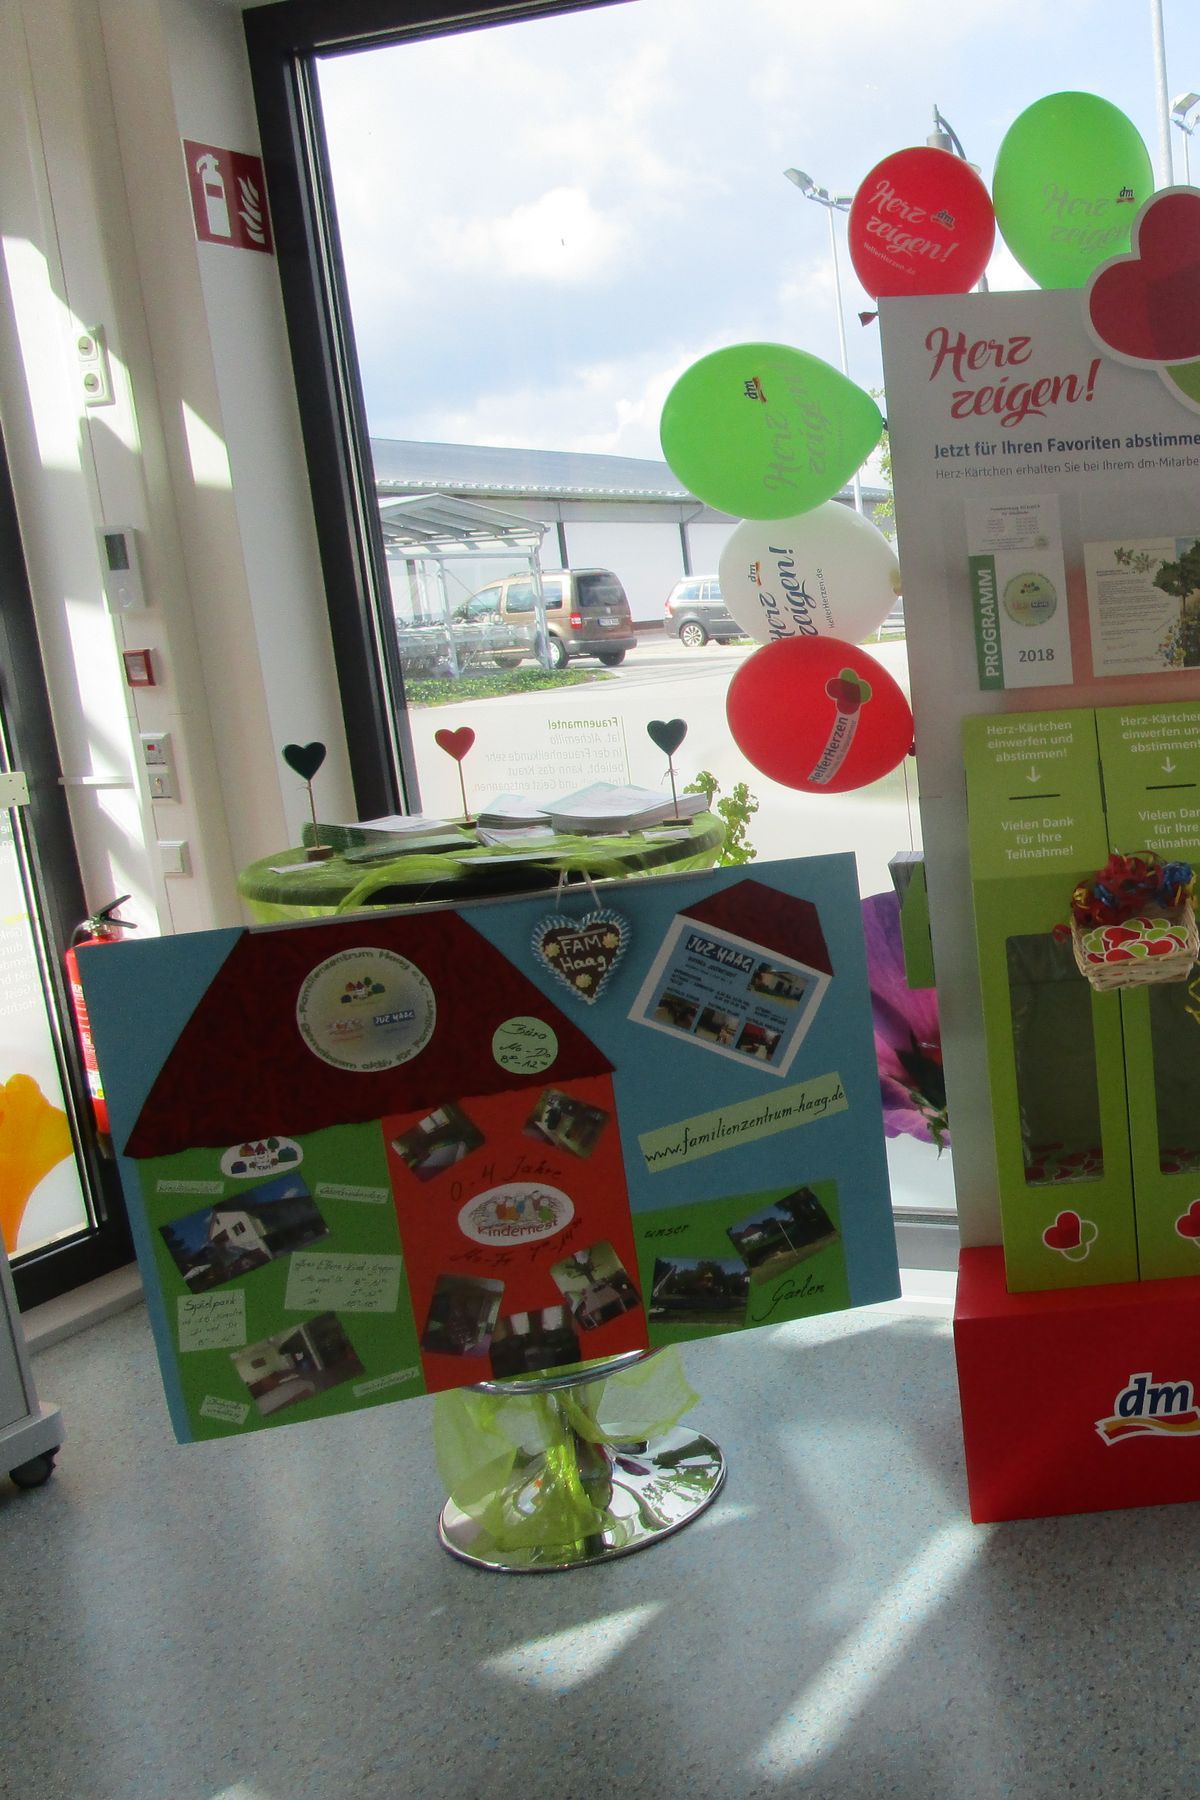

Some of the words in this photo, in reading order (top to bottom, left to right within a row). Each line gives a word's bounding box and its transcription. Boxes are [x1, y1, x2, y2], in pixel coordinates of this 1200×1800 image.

[1119, 186, 1134, 198] dm
[868, 180, 926, 224] Herz
[865, 215, 959, 264] zeigen!
[924, 326, 1032, 383] Herz
[743, 379, 758, 400] dm
[950, 358, 1102, 428] zeigen!
[935, 443, 970, 459] Jetzt
[974, 440, 997, 456] für
[1002, 439, 1043, 455] Ihren
[1048, 436, 1121, 454] Favoriten
[936, 464, 1013, 480] Herz-Kärtchen
[1016, 461, 1061, 475] erhalten
[1064, 461, 1080, 473] Sie
[1083, 460, 1099, 472] bei
[1103, 458, 1134, 471] Ihrem
[769, 546, 819, 637] zeigen!
[977, 569, 999, 677] PROGRAMM
[1019, 648, 1055, 663] 2018
[987, 720, 1072, 736] Herz-Kärtchen
[1122, 727, 1180, 741] einwerfen
[809, 716, 849, 783] HelferHerzen
[987, 736, 1047, 749] einwerfen
[1050, 734, 1073, 746] und
[1130, 739, 1200, 753] abstimmen!
[995, 749, 1067, 763] abstimmen!
[1138, 808, 1177, 821] Vielen
[1001, 819, 1039, 832] Vielen
[1043, 817, 1074, 829] Dank
[1153, 821, 1172, 834] für
[1175, 822, 1199, 833] Ihre
[1016, 832, 1034, 845] für
[1037, 832, 1062, 843] Ihre
[1005, 845, 1074, 861] Teilnahme!
[560, 935, 602, 955] FAM
[379, 951, 410, 972] Haag
[560, 955, 607, 972] Haag
[645, 1085, 844, 1163] www.familienzentrum-haag.de
[644, 1223, 690, 1239] unser
[1118, 1376, 1190, 1418] dm
